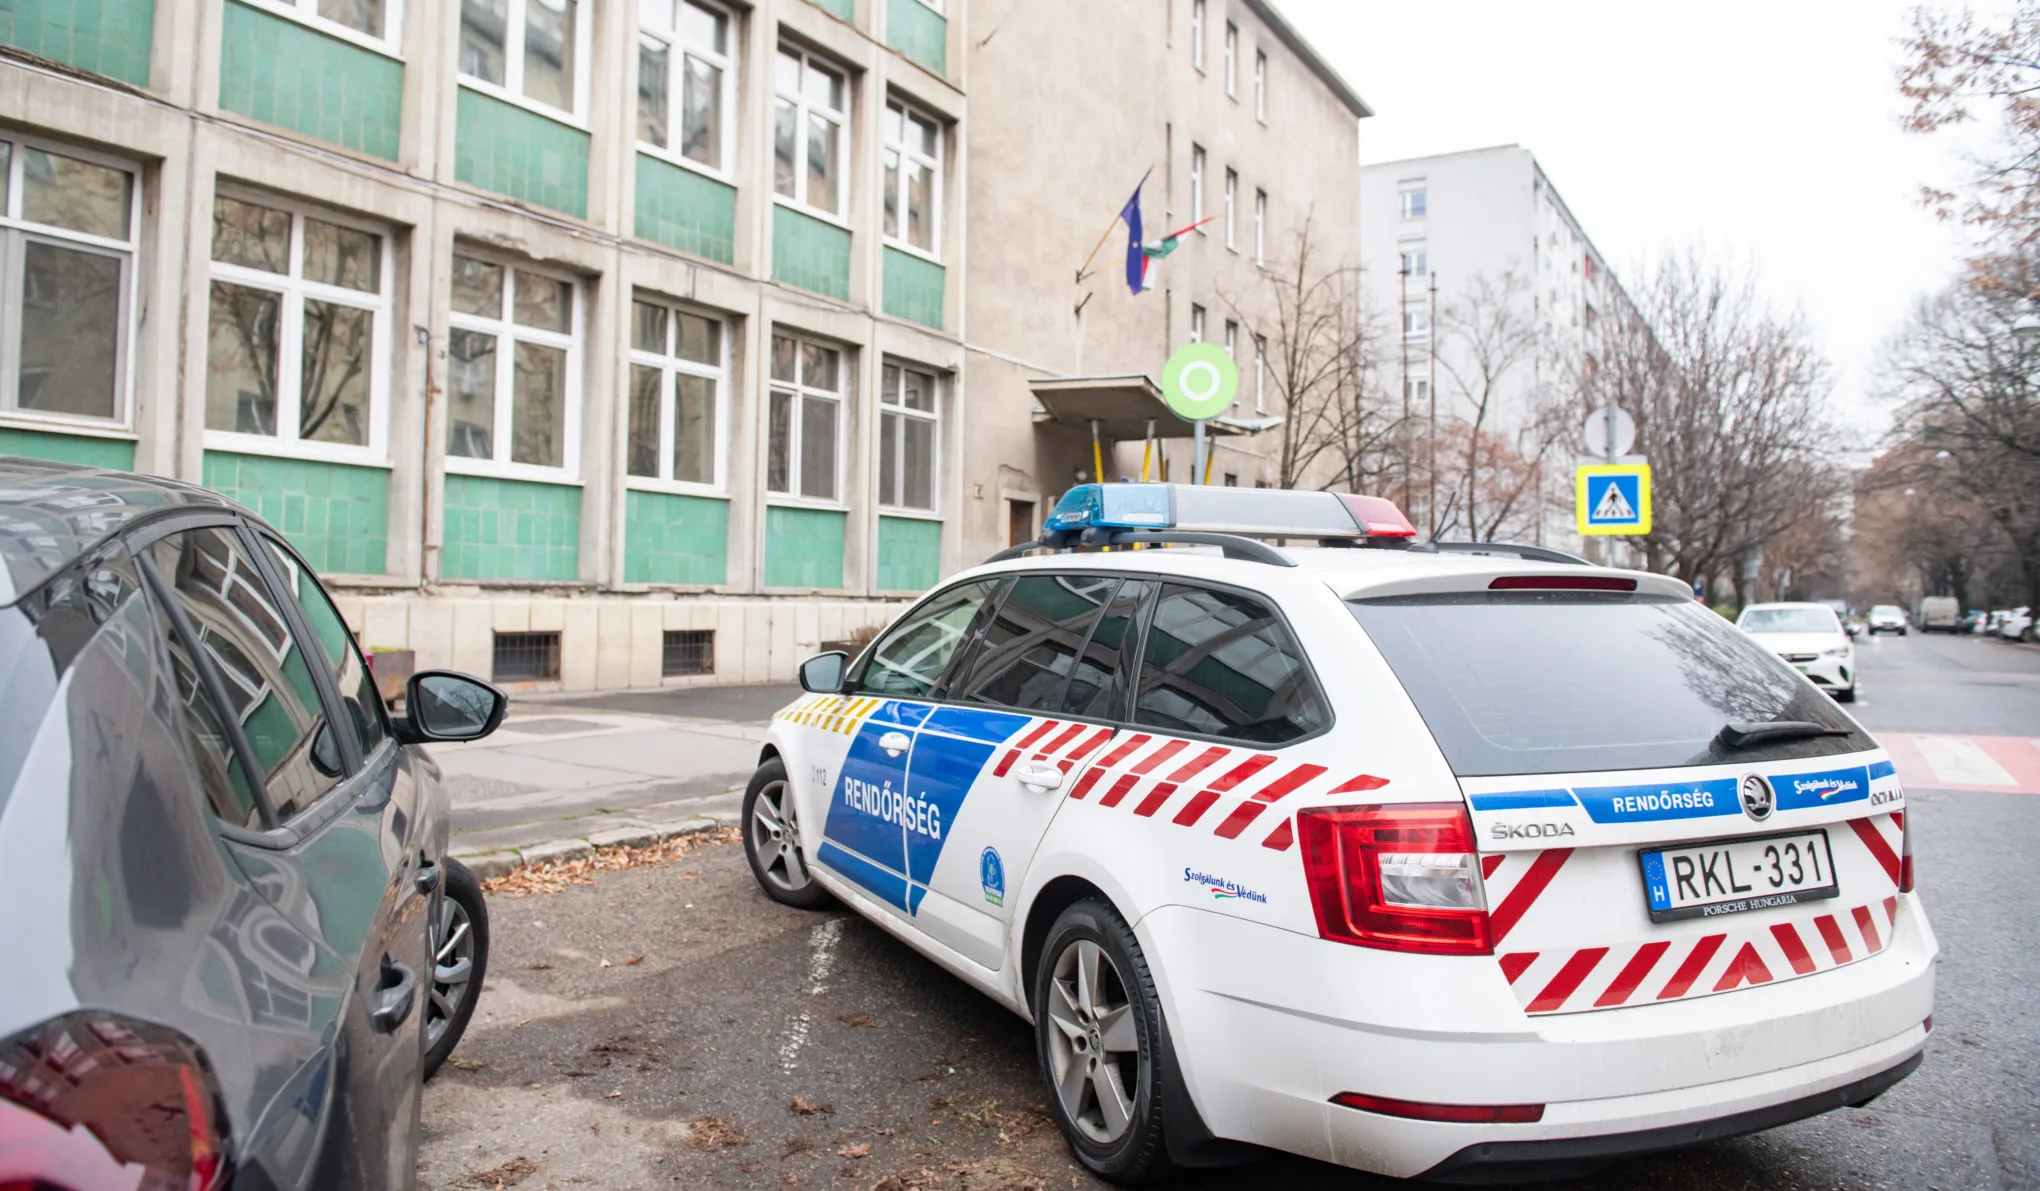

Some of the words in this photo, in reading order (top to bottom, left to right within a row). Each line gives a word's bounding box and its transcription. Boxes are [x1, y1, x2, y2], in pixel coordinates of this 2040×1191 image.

[845, 776, 941, 840] RENDŐRSÉG
[1612, 789, 1714, 813] RENDŐRSÉG
[1491, 822, 1575, 839] ŠKODA
[1672, 840, 1822, 901] RKL-331
[1184, 867, 1225, 888] Szolgálunk
[1226, 880, 1235, 891] és
[1236, 884, 1267, 904] Védünk
[1653, 886, 1666, 902] H
[1703, 902, 1748, 916] PORSCHE
[1750, 894, 1797, 910] HUNGARIA
